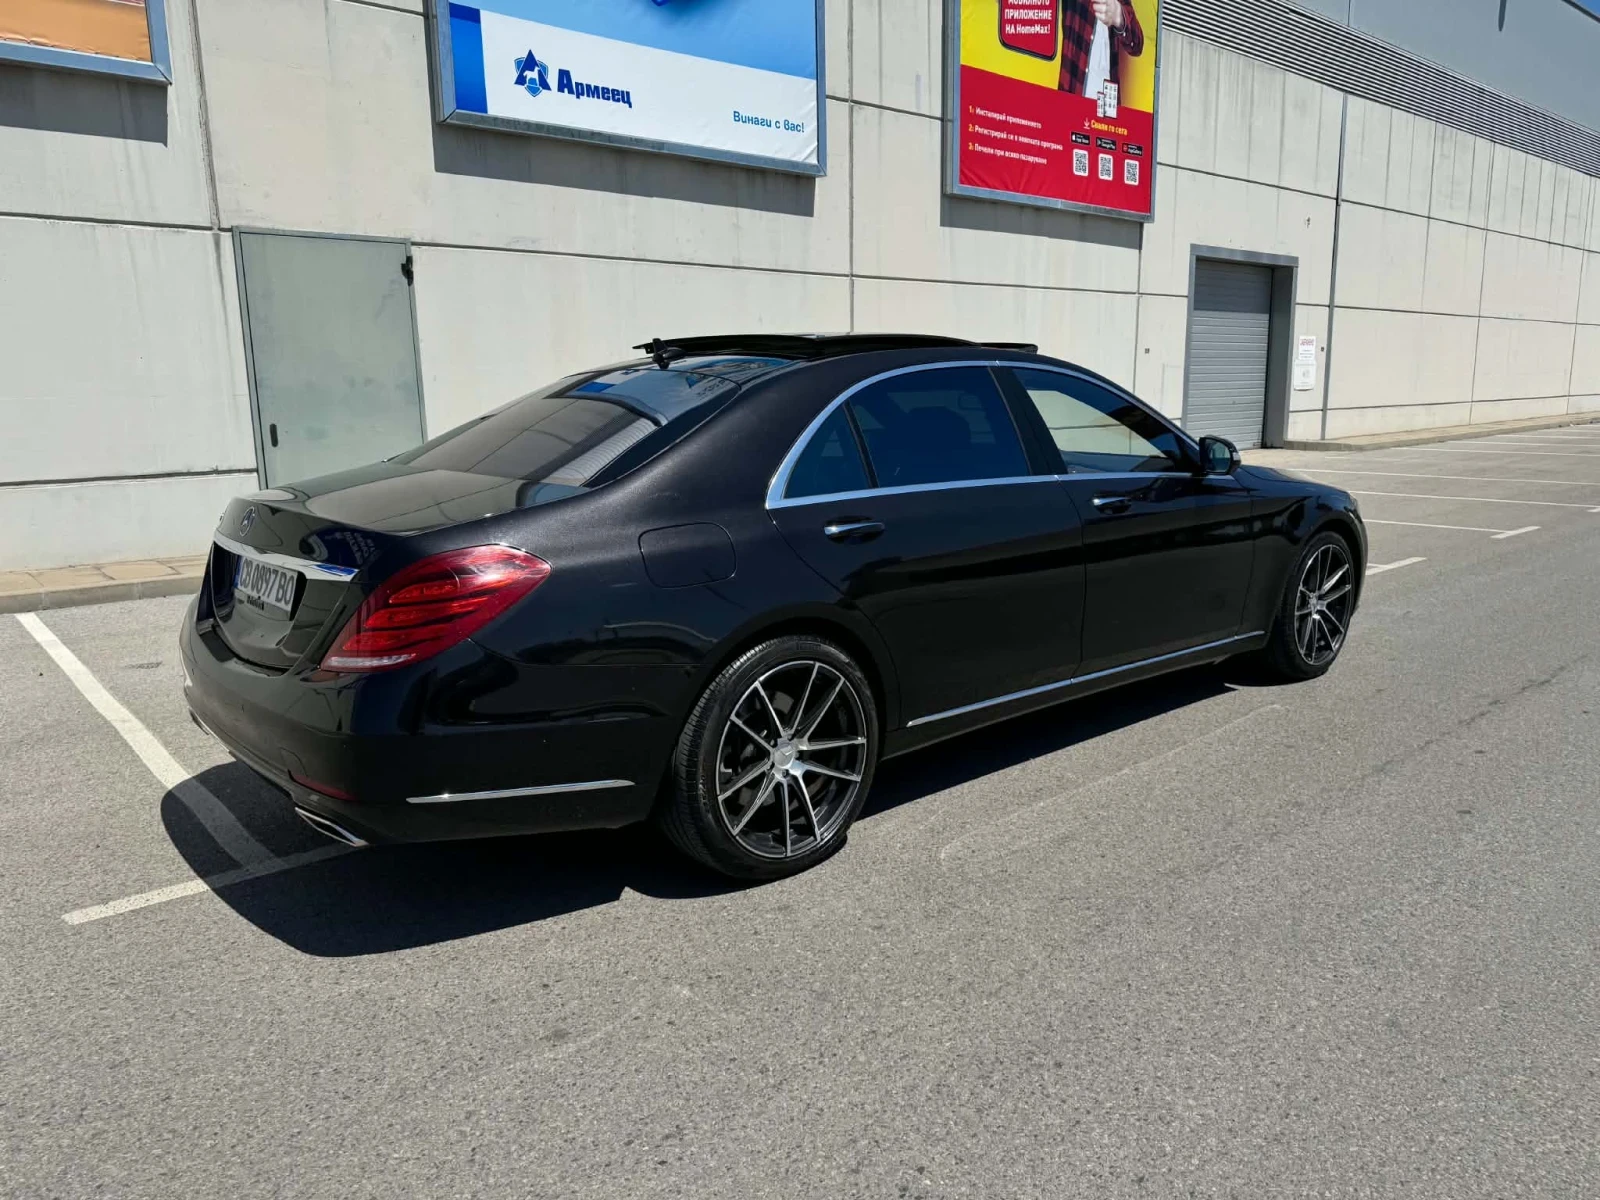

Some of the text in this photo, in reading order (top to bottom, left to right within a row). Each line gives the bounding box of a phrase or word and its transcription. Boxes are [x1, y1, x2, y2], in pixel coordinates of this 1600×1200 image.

[1004, 9, 1052, 20] ПРИЛОЖЕНИЕ
[1005, 24, 1050, 34] НА HomeMax!
[557, 68, 632, 109] Армеец
[733, 110, 805, 133] Винаги с вас!
[975, 124, 1006, 139] Регистрирай
[1116, 127, 1128, 136] сега
[995, 148, 1004, 157] при
[240, 558, 253, 589] CB
[251, 563, 280, 599] 0897
[275, 571, 294, 606] BO
